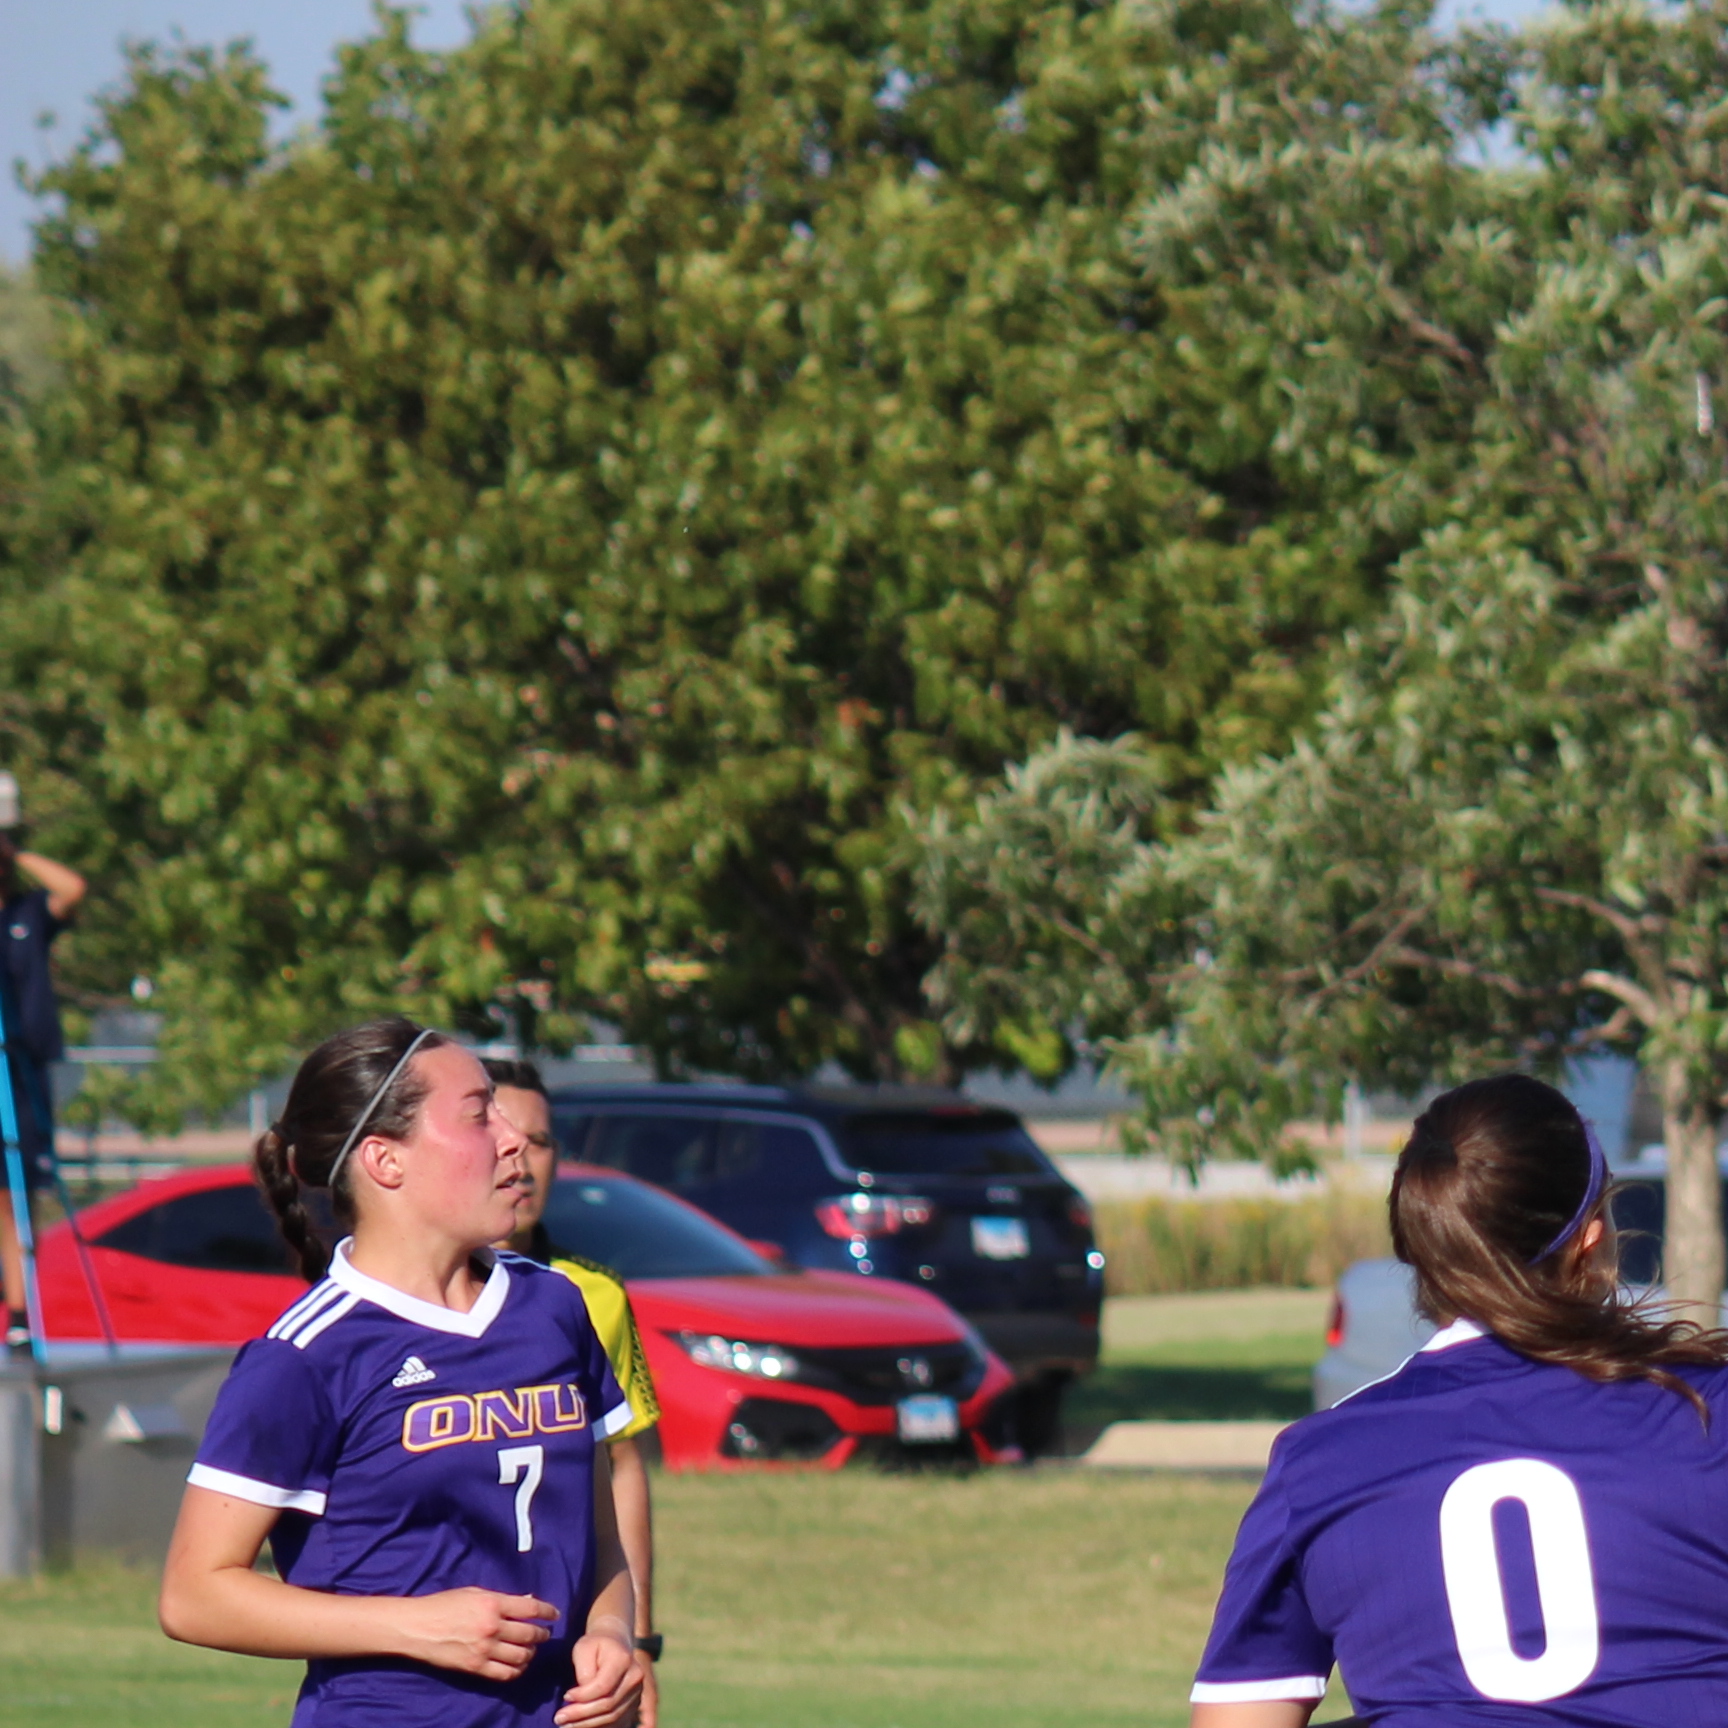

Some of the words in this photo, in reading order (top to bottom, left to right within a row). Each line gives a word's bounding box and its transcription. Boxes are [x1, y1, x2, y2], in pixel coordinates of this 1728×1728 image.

[402, 1383, 587, 1453] ONU
[497, 1445, 544, 1553] 7
[1438, 1458, 1600, 1704] 0
